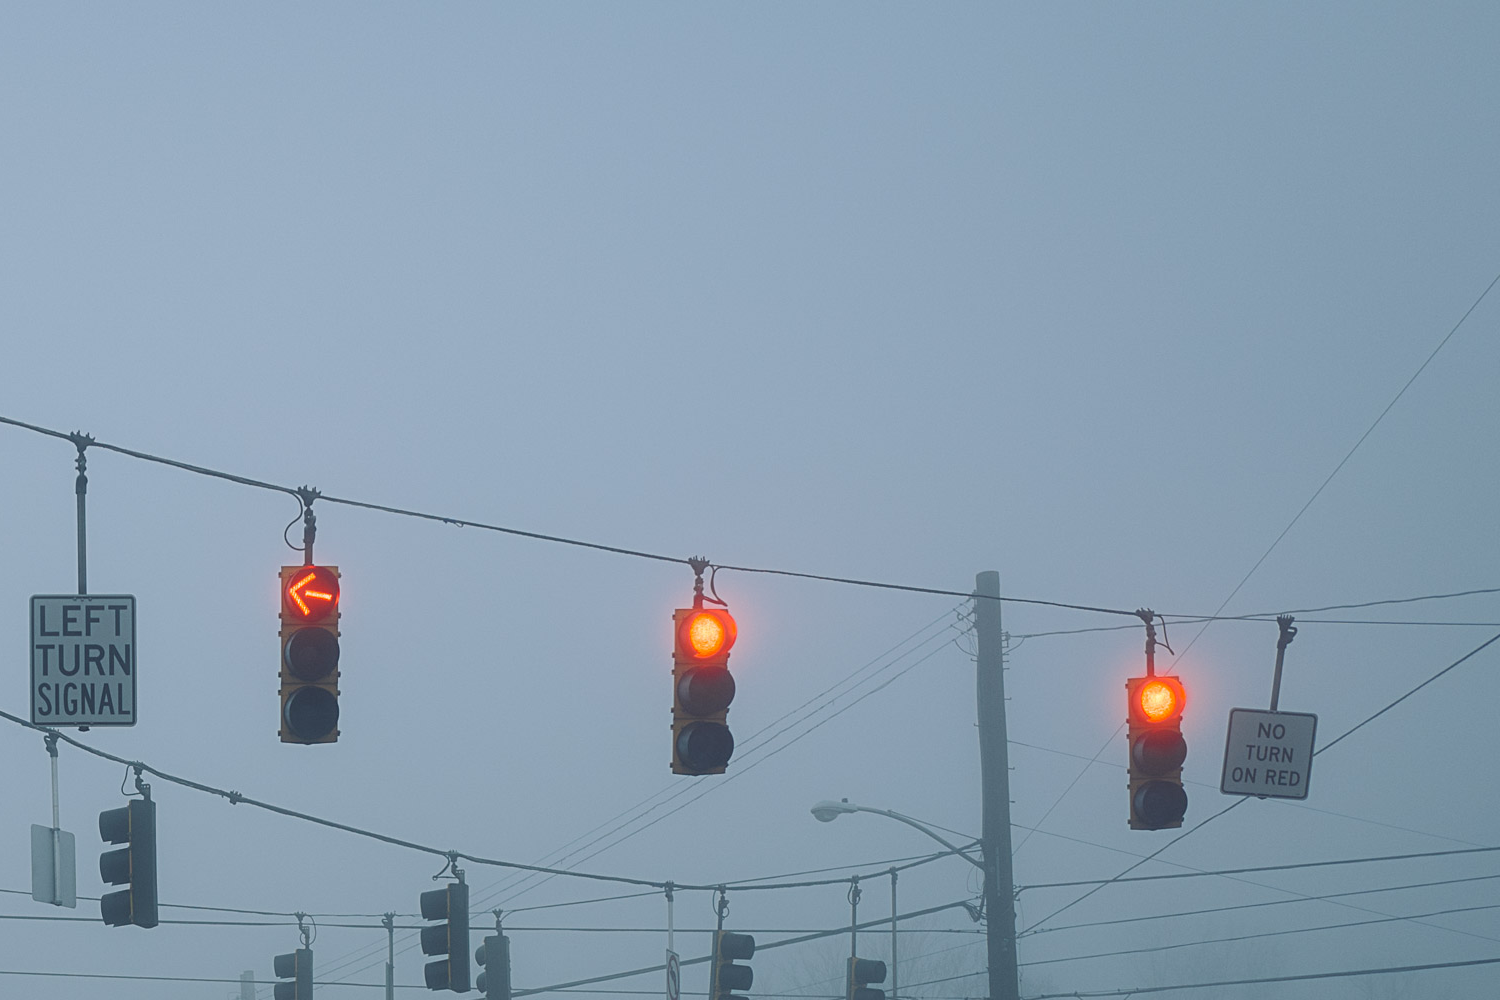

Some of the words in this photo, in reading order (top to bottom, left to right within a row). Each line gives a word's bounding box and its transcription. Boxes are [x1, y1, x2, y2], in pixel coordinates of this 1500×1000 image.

[39, 605, 128, 637] LEFT
[35, 644, 131, 676] TURN
[37, 682, 131, 716] SIGNAL
[1257, 722, 1286, 740] NO
[1246, 744, 1294, 763] TURN
[1231, 766, 1257, 784] ON
[1265, 769, 1301, 787] RED
